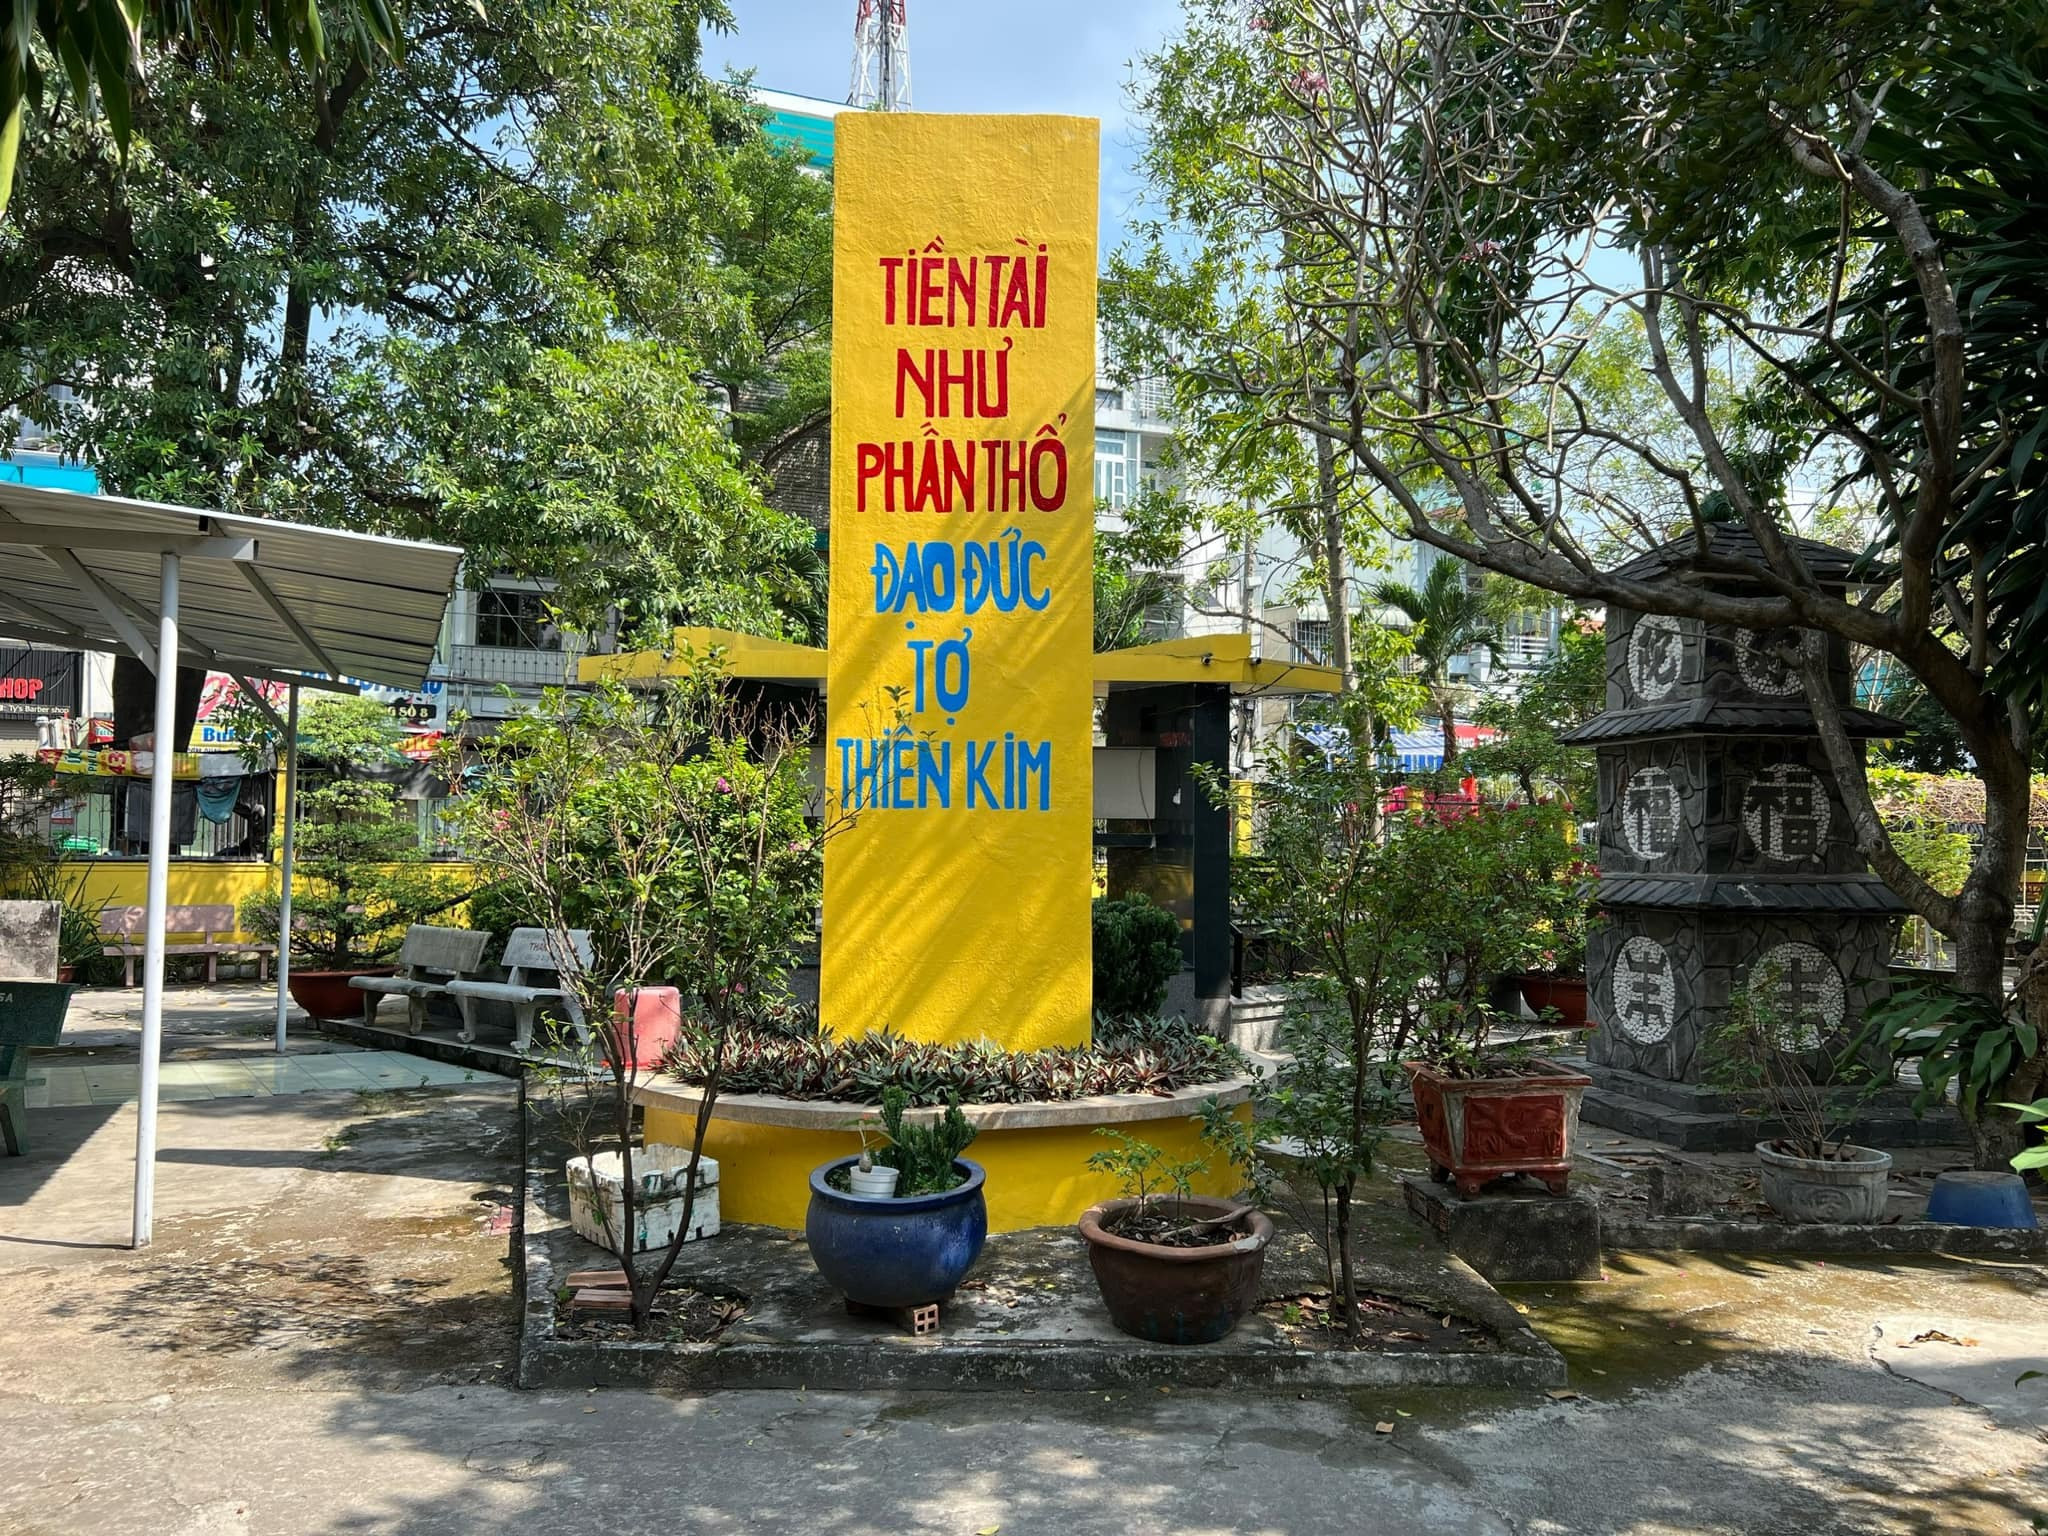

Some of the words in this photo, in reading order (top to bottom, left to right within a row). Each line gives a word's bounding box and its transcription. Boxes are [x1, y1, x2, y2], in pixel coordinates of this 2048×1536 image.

[879, 235, 978, 328] TIỀN
[983, 237, 1049, 328] TÀI
[896, 336, 1013, 418] NHƯ
[980, 413, 1068, 513] THỔ
[869, 541, 955, 630] ĐẠO
[961, 526, 1051, 615] ĐỨC
[25, 705, 49, 713] Barber
[51, 706, 70, 715] shop
[420, 708, 429, 718] 8
[836, 725, 950, 810] THIÊN
[966, 732, 1051, 811] KIM
